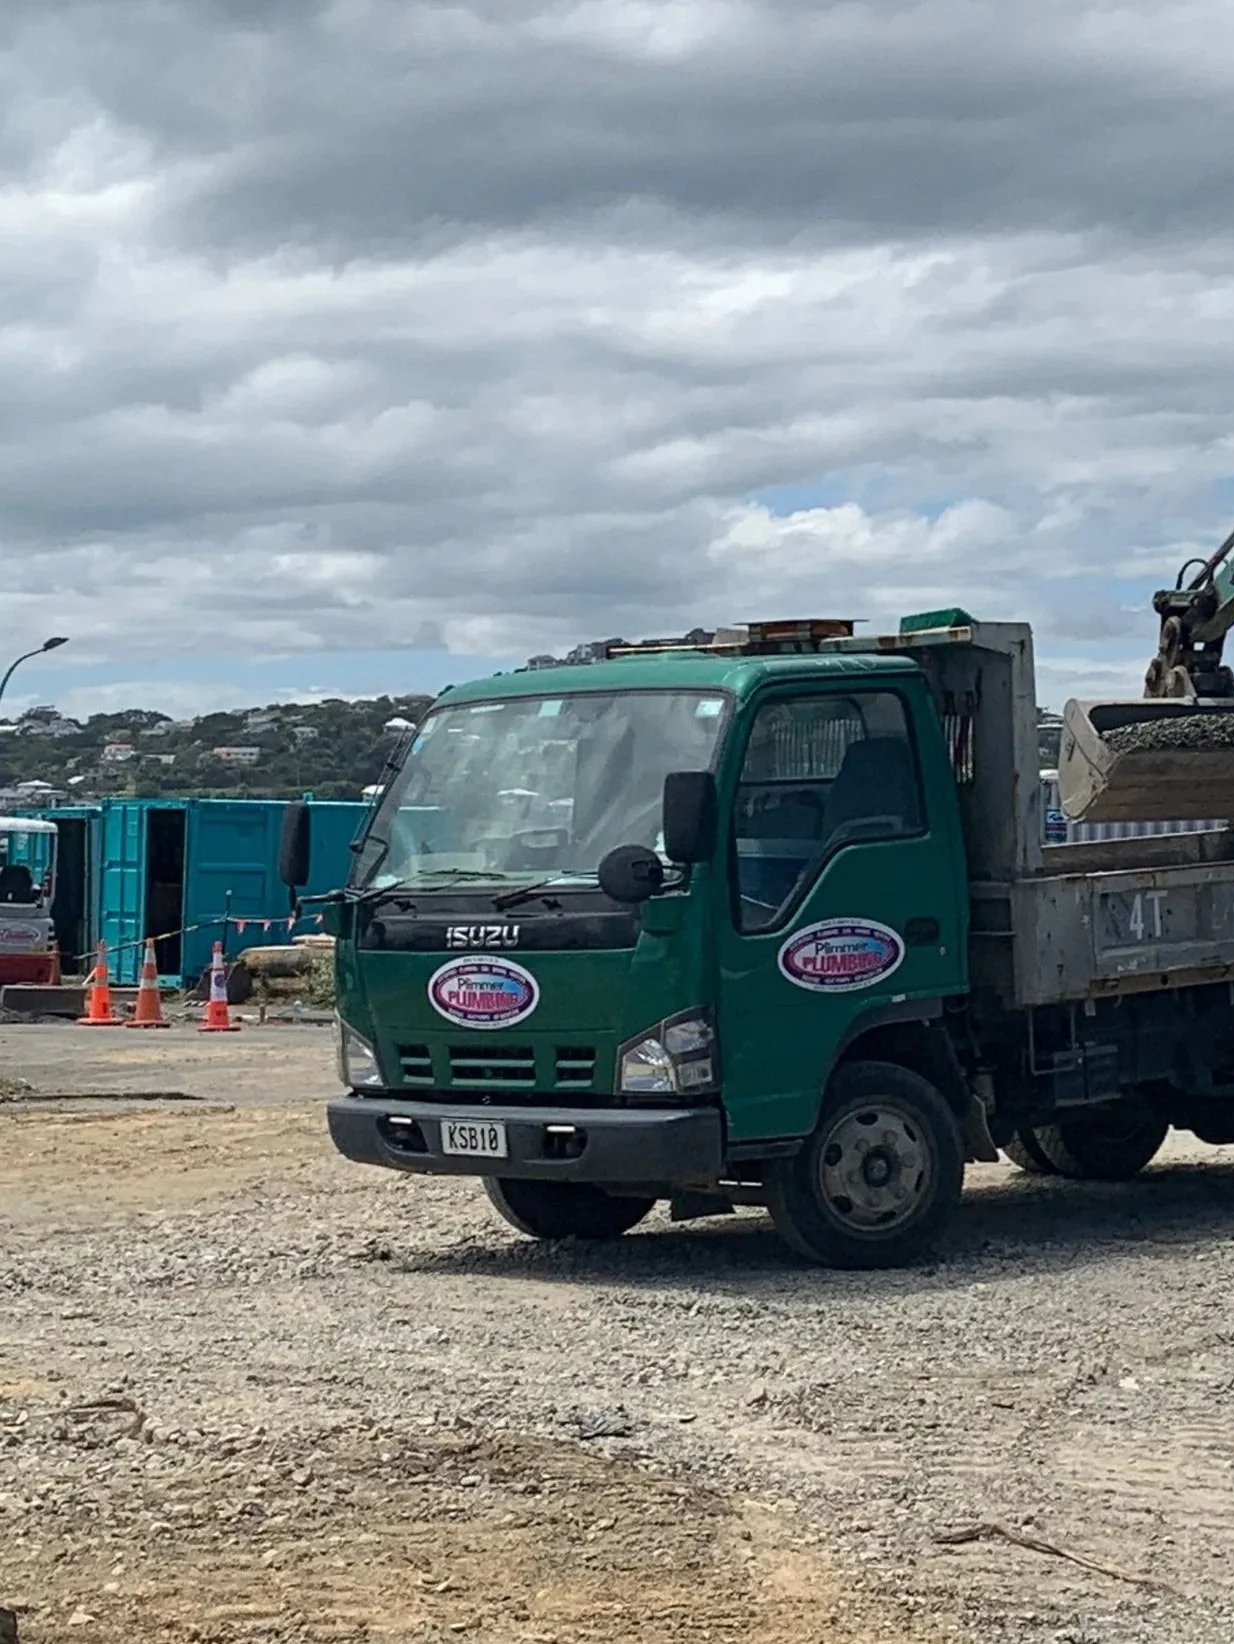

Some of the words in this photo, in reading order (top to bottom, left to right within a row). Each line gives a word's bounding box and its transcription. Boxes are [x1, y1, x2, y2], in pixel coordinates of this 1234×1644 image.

[1129, 890, 1169, 940] 4T
[446, 925, 520, 948] ISUZU
[814, 941, 869, 955] Plimmer
[448, 1125, 499, 1151] KSB10
